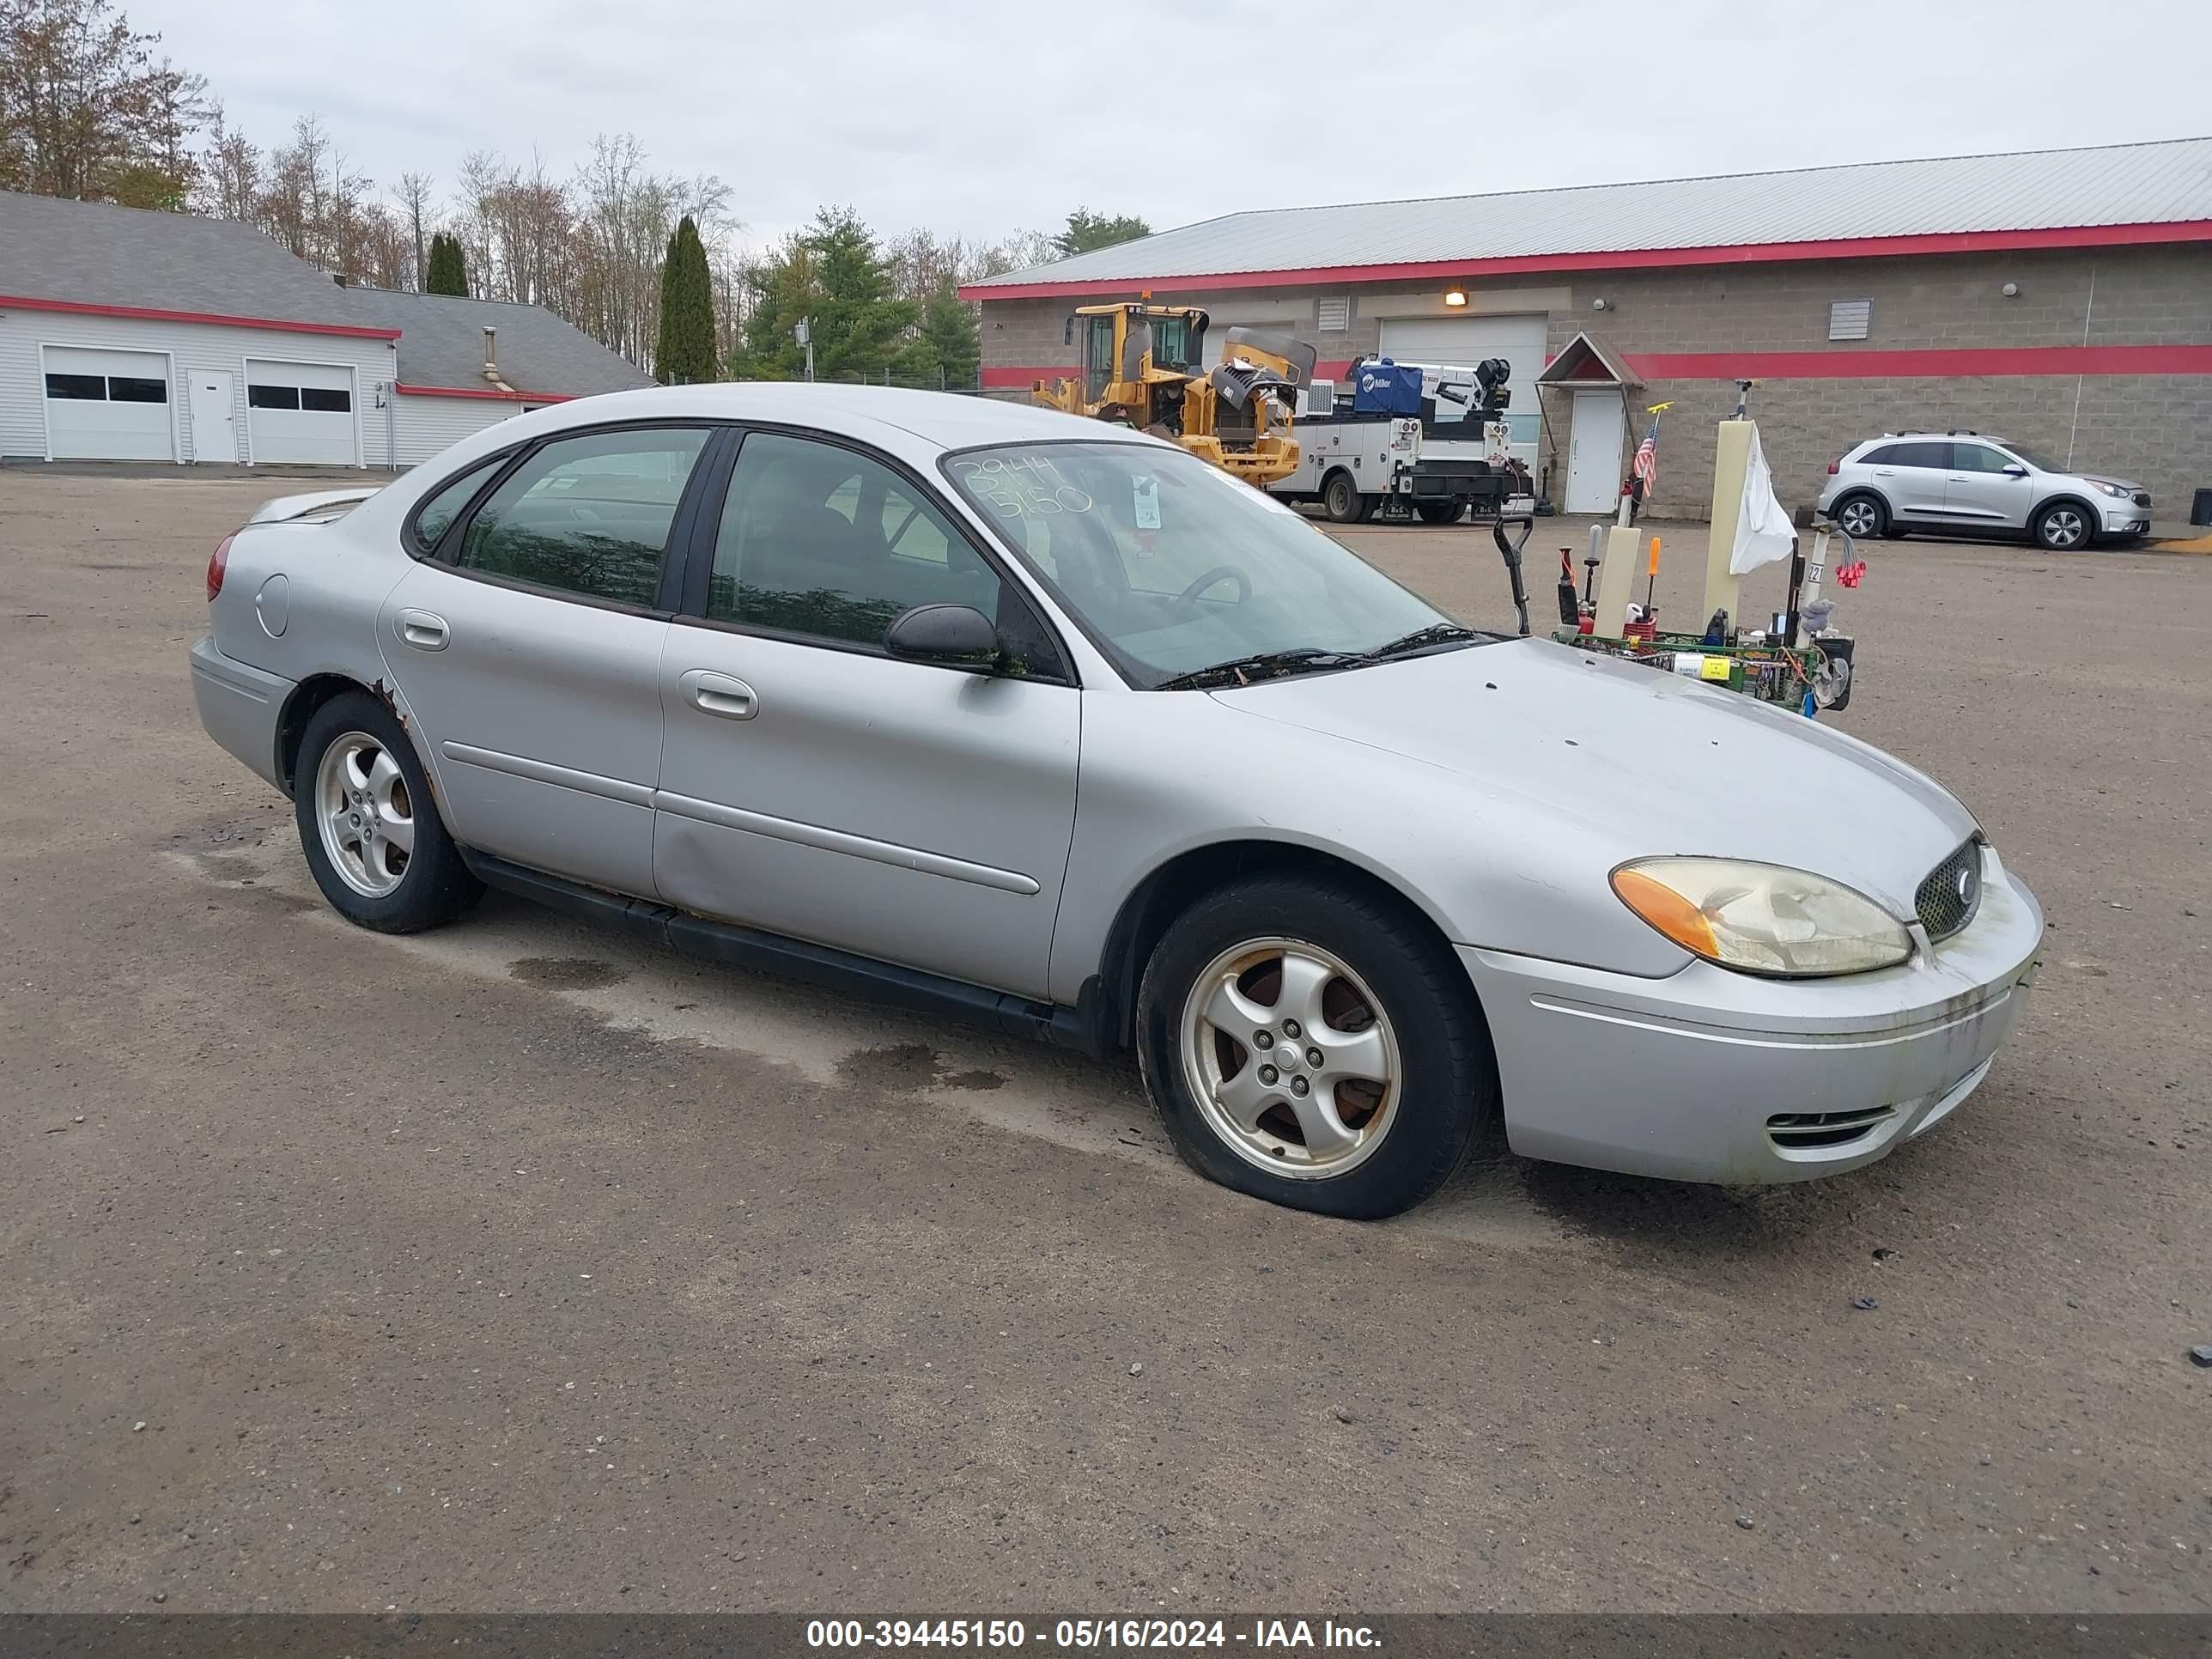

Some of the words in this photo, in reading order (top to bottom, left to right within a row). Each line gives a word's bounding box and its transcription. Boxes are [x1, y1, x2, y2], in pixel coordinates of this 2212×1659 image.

[1374, 378, 1391, 388] Miller
[954, 456, 1066, 493] 3944
[990, 487, 1092, 518] 5150
[1808, 565, 1823, 581] 221
